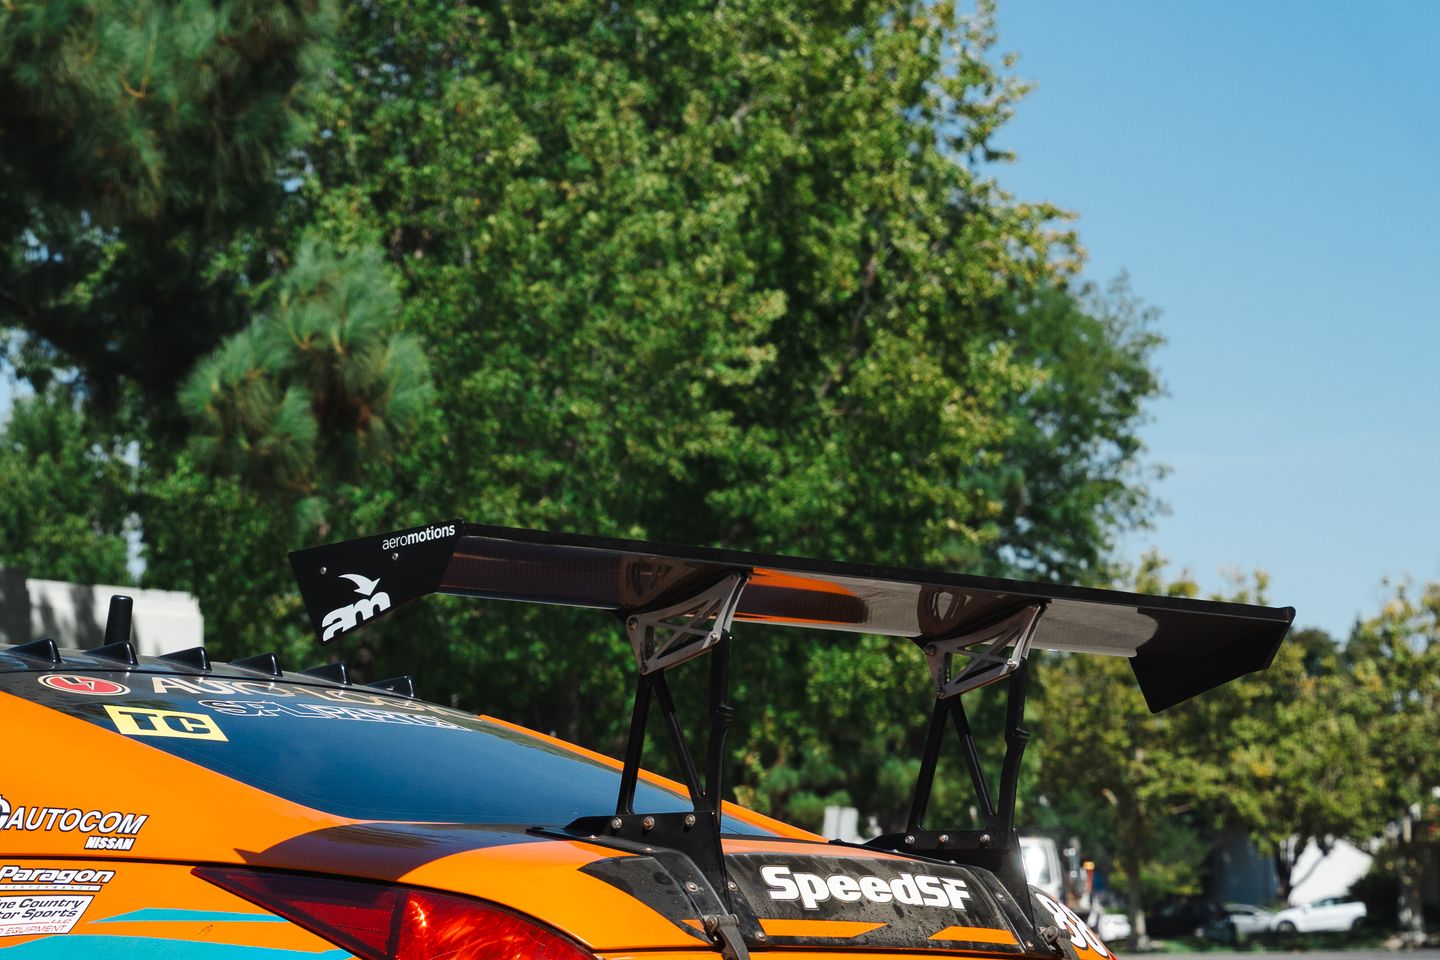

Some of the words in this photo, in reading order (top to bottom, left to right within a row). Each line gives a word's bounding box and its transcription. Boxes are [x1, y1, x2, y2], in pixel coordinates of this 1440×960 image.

[382, 524, 456, 550] aeromotions
[117, 710, 213, 736] TC
[4, 806, 150, 835] AUTOCOM
[84, 835, 136, 851] NISSAN
[760, 865, 972, 911] SpeedSF
[19, 898, 85, 909] Country
[22, 909, 78, 919] Sports
[6, 925, 67, 934] EQUIPMENT
